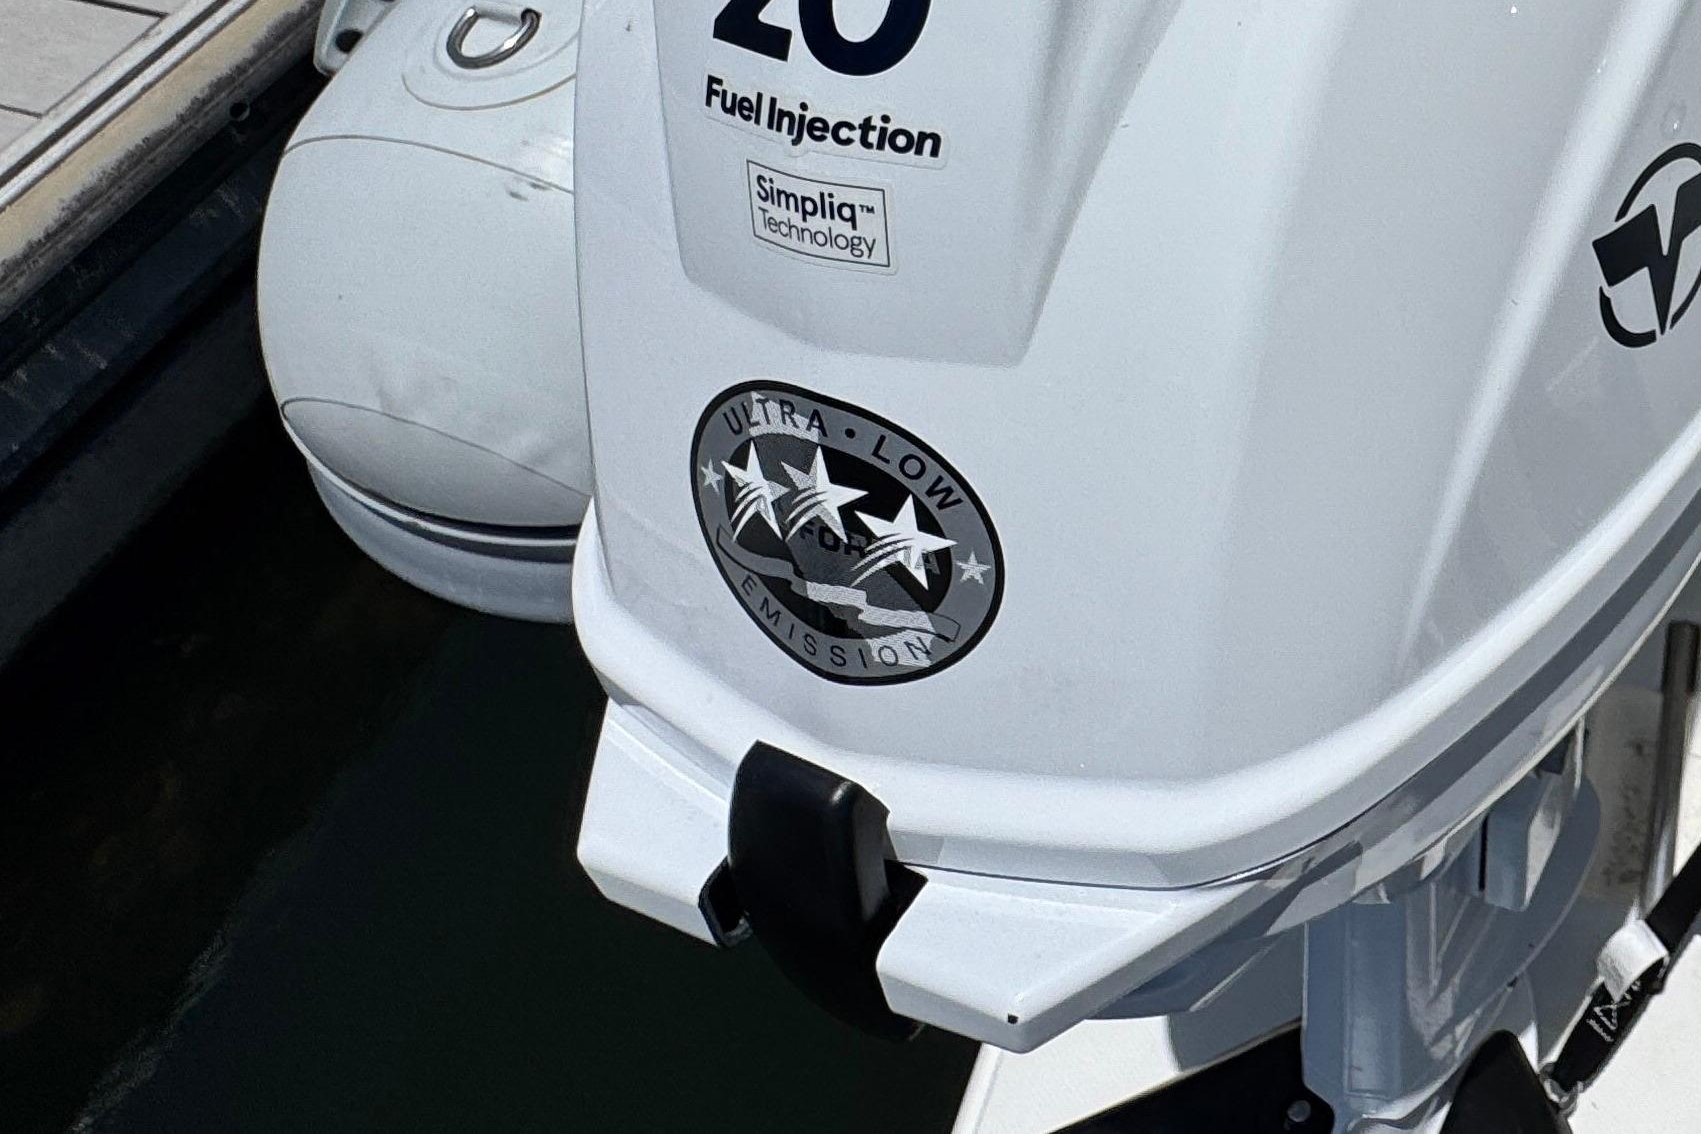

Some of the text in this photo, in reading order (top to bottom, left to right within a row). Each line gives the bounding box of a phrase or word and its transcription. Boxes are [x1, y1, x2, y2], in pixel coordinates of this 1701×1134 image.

[705, 74, 942, 158] Fuel Injection
[759, 207, 876, 258] Technology
[722, 398, 963, 511] ULTRA LOW
[741, 573, 933, 670] EMISSION
